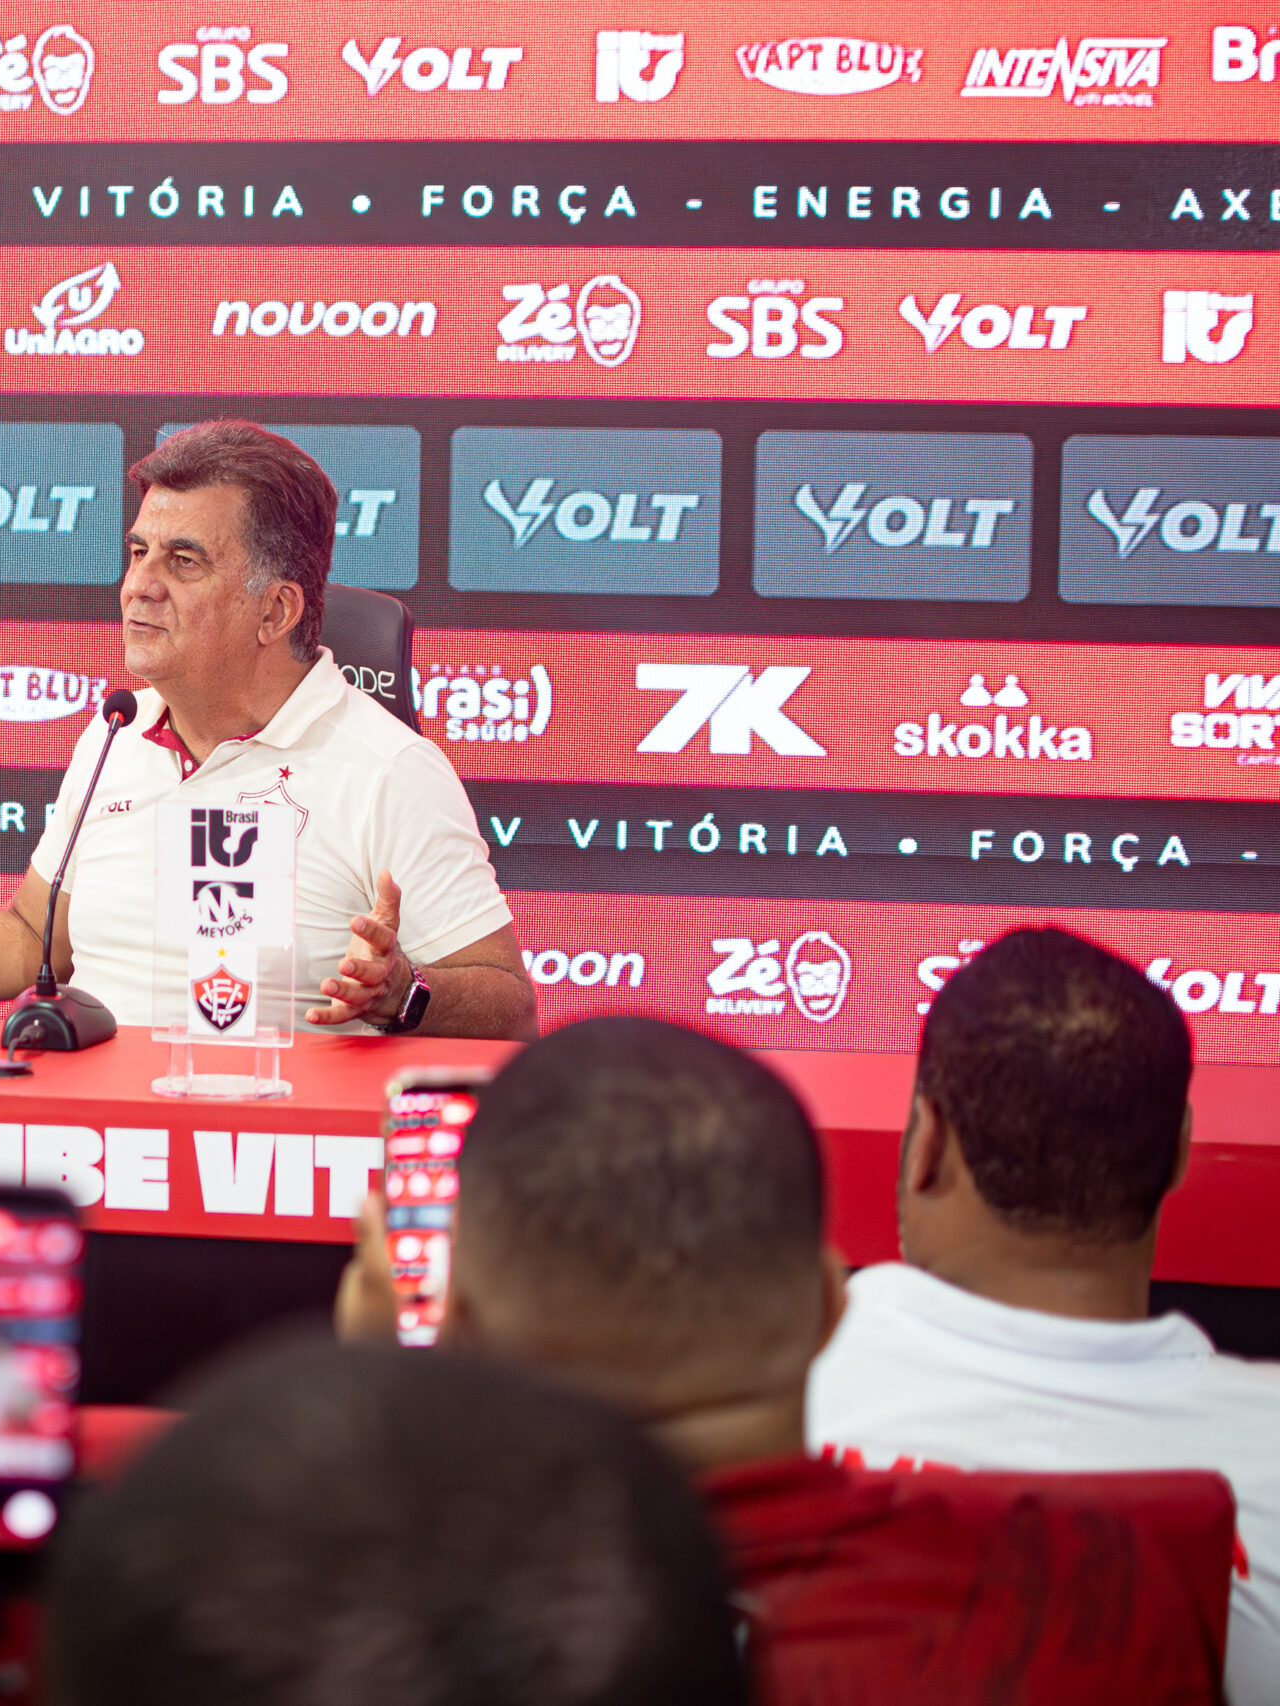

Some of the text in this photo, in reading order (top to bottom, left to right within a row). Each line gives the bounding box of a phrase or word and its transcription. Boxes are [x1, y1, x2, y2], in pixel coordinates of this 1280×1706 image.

[158, 43, 287, 104] SBS
[343, 38, 522, 94] VOLT
[735, 42, 823, 80] VAPT
[961, 35, 1169, 102] INTENSIVA
[33, 177, 303, 218] VITÓRIA
[422, 185, 635, 224] FORÇA
[753, 186, 1051, 219] ENERGIA
[213, 301, 436, 336] novoon
[497, 283, 577, 343] Zé
[707, 296, 842, 358] SBS
[900, 294, 1086, 351] VOLT
[484, 479, 699, 548] VOLT
[796, 483, 1013, 554] VOLT
[334, 664, 396, 699] ODE
[636, 663, 826, 756] 7K
[893, 712, 1092, 761] skokka
[225, 810, 259, 823] Brasil
[568, 813, 847, 856] VITÓRIA
[971, 830, 1189, 872] FORÇA
[197, 913, 253, 938] MEYOR'S
[706, 937, 788, 996] Zé
